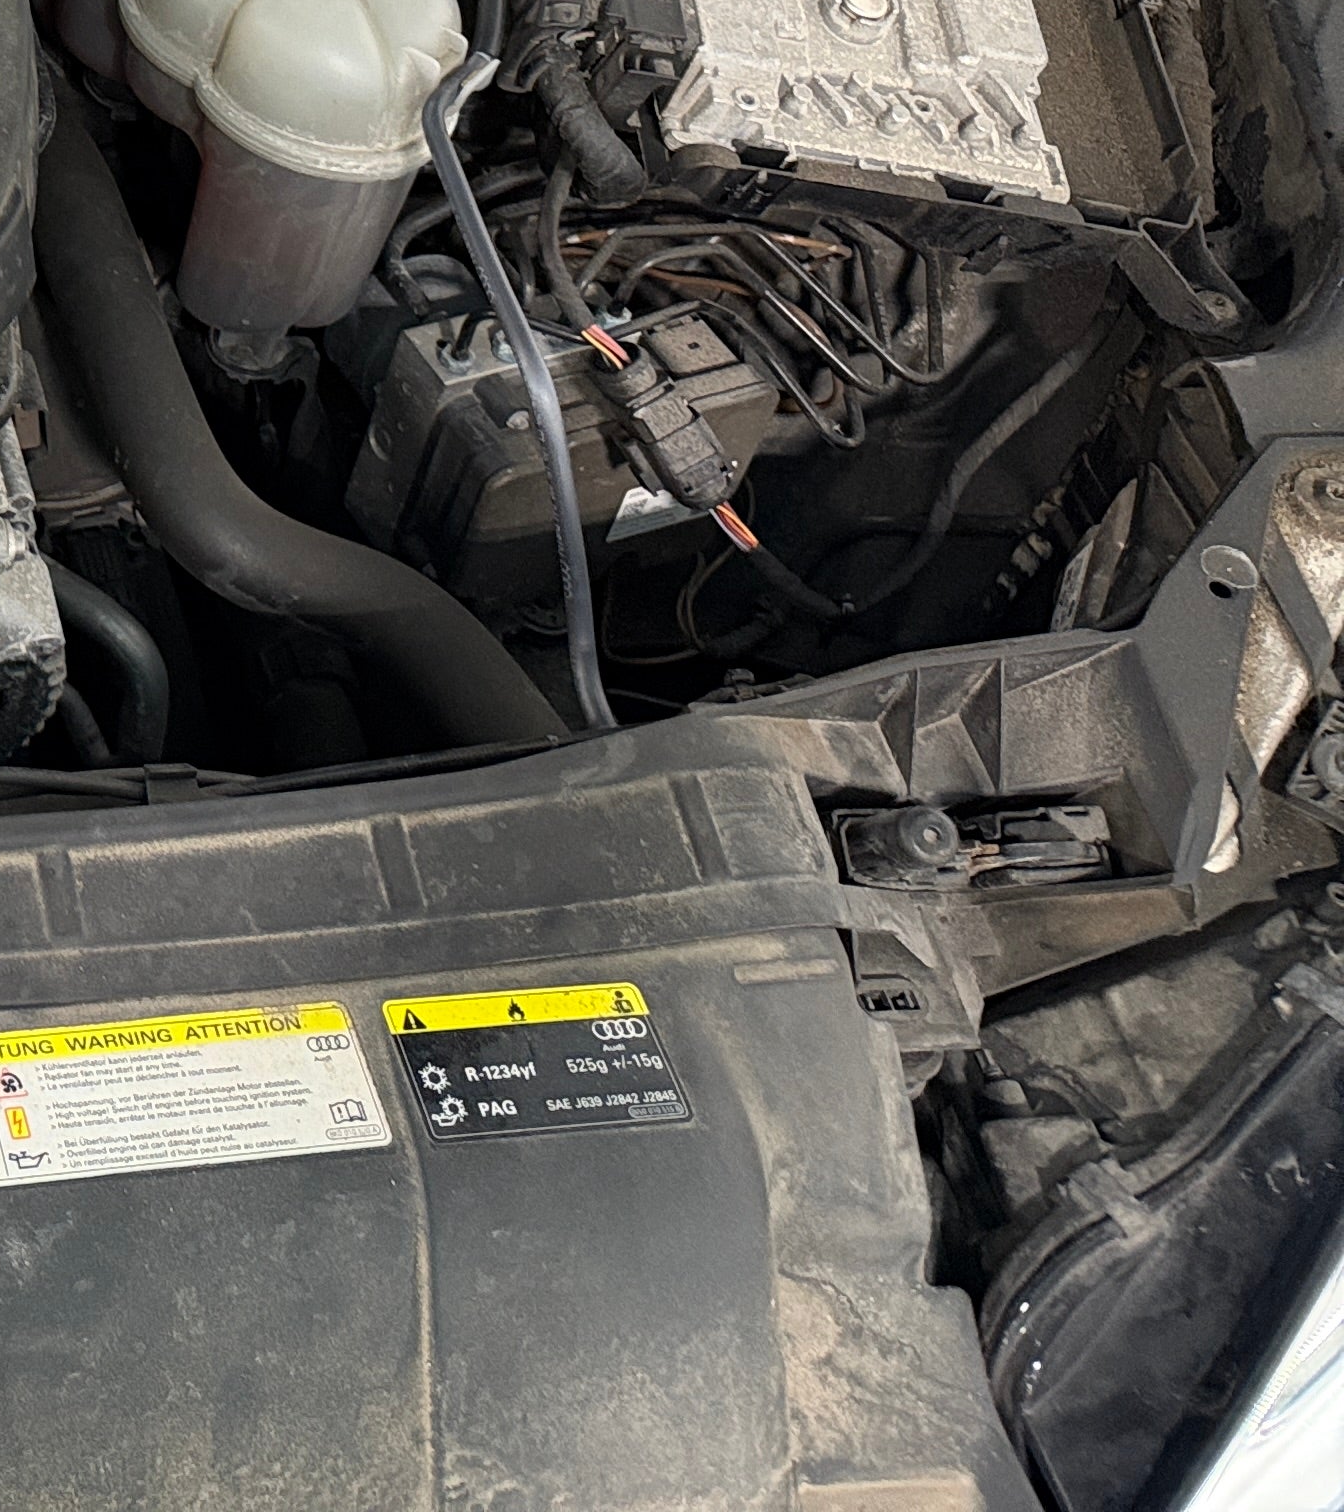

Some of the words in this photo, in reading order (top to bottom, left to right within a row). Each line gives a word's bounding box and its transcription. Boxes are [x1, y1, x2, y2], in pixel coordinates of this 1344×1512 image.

[64, 1028, 172, 1051] WARNING
[185, 1016, 301, 1040] ATTENTION
[602, 1043, 626, 1052] Audi
[464, 1061, 537, 1083] R-1234yf
[565, 1057, 609, 1074] 525g
[611, 1052, 664, 1070] +/-15g
[478, 1099, 518, 1118] PAG
[545, 1097, 573, 1112] SAE
[575, 1095, 604, 1109] J639
[605, 1092, 641, 1107] J2842
[642, 1089, 678, 1104] J2845
